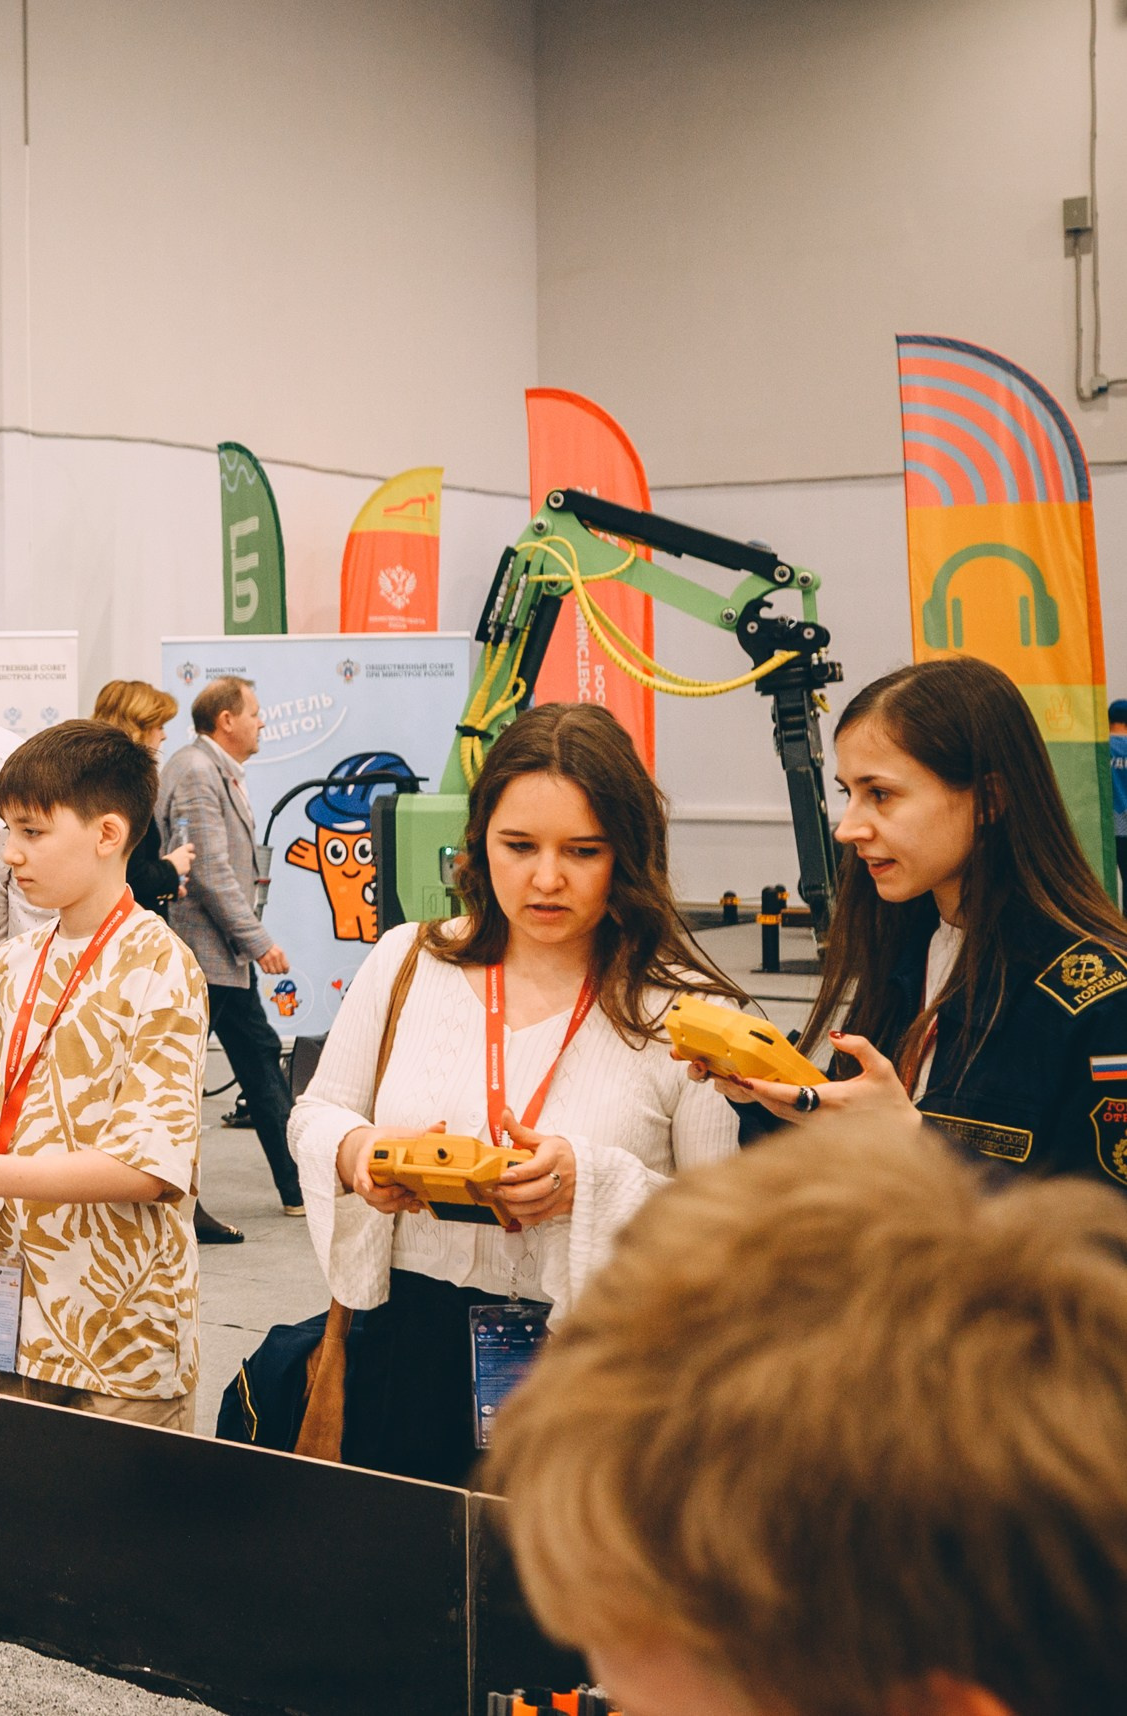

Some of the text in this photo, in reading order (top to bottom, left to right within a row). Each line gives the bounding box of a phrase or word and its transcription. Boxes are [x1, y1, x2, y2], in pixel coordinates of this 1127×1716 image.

[429, 662, 454, 670] СОВЕТ
[423, 669, 455, 677] РОССИИ
[1107, 1101, 1127, 1111] ГО
